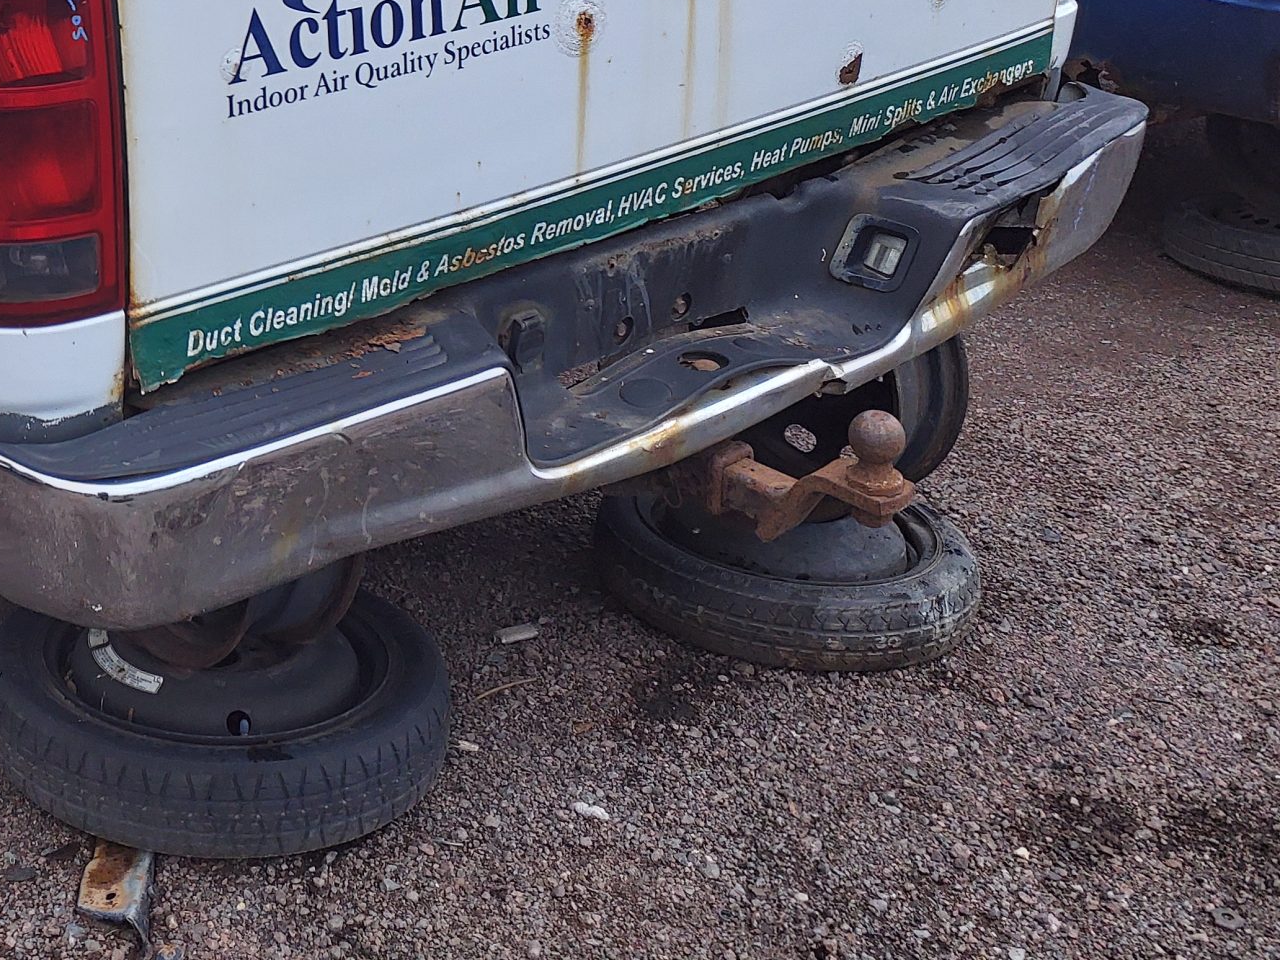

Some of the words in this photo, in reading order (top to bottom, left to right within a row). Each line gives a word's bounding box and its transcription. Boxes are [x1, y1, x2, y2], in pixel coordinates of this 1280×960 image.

[226, 85, 310, 119] Indoor
[313, 70, 350, 97] Air
[354, 48, 439, 89] Quality
[443, 22, 552, 70] Specialists
[186, 317, 243, 358] Duct
[248, 281, 356, 337] Cleaning/
[361, 265, 413, 303] Mold
[416, 259, 431, 283] &
[434, 232, 525, 277] Asbestos
[530, 197, 616, 245] Removal,
[618, 182, 668, 217] HVAC
[672, 161, 745, 199] Services,
[750, 144, 787, 171] Heat
[789, 128, 844, 158] Pumps,
[848, 109, 881, 136] Mini
[883, 99, 923, 128] Splits
[926, 90, 937, 111] &
[938, 80, 960, 105] Air
[960, 58, 1035, 98] Exchangers
